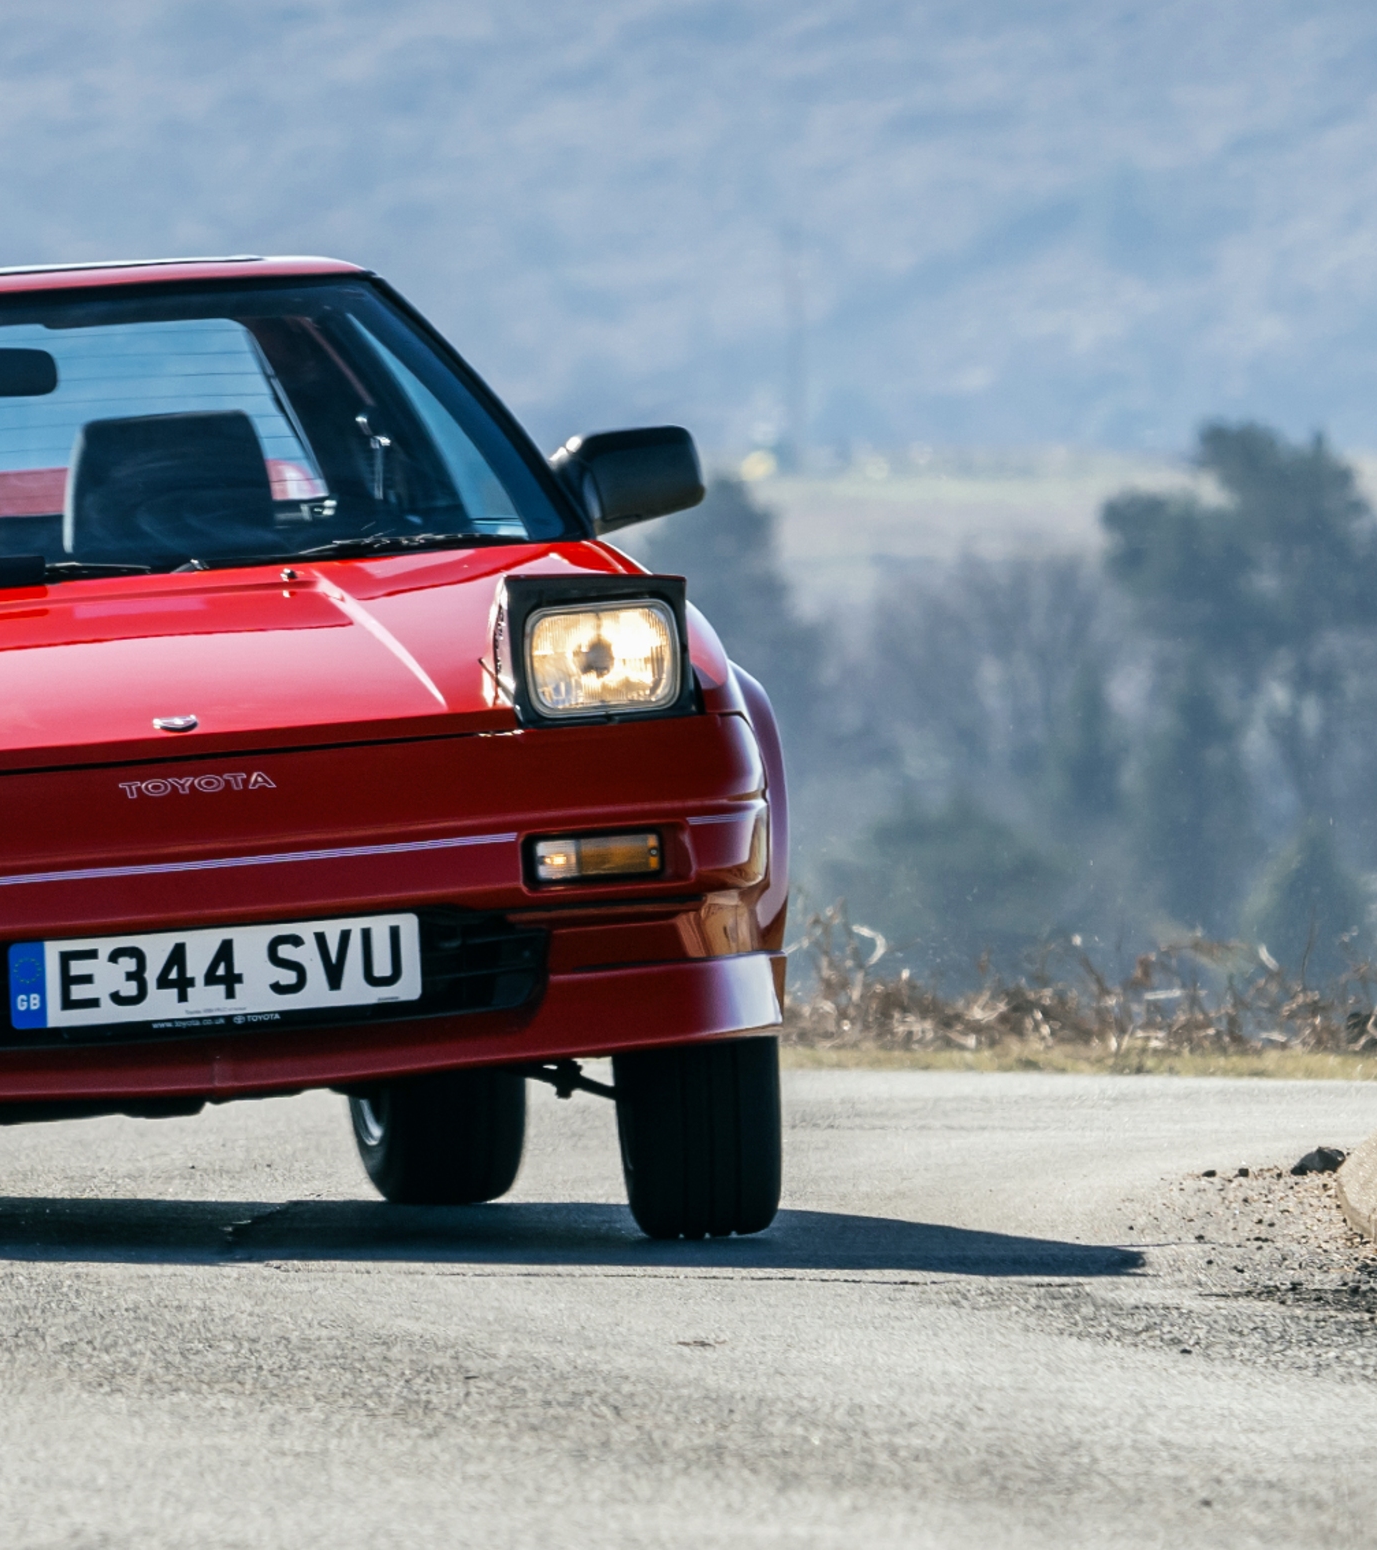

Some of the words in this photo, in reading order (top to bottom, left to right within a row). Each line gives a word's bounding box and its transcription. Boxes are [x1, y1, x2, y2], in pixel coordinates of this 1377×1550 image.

[119, 771, 277, 799] TOYOTA
[58, 938, 244, 1011] E344
[266, 924, 404, 996] SVU
[16, 993, 41, 1011] GB
[246, 1013, 281, 1023] TOYOTA
